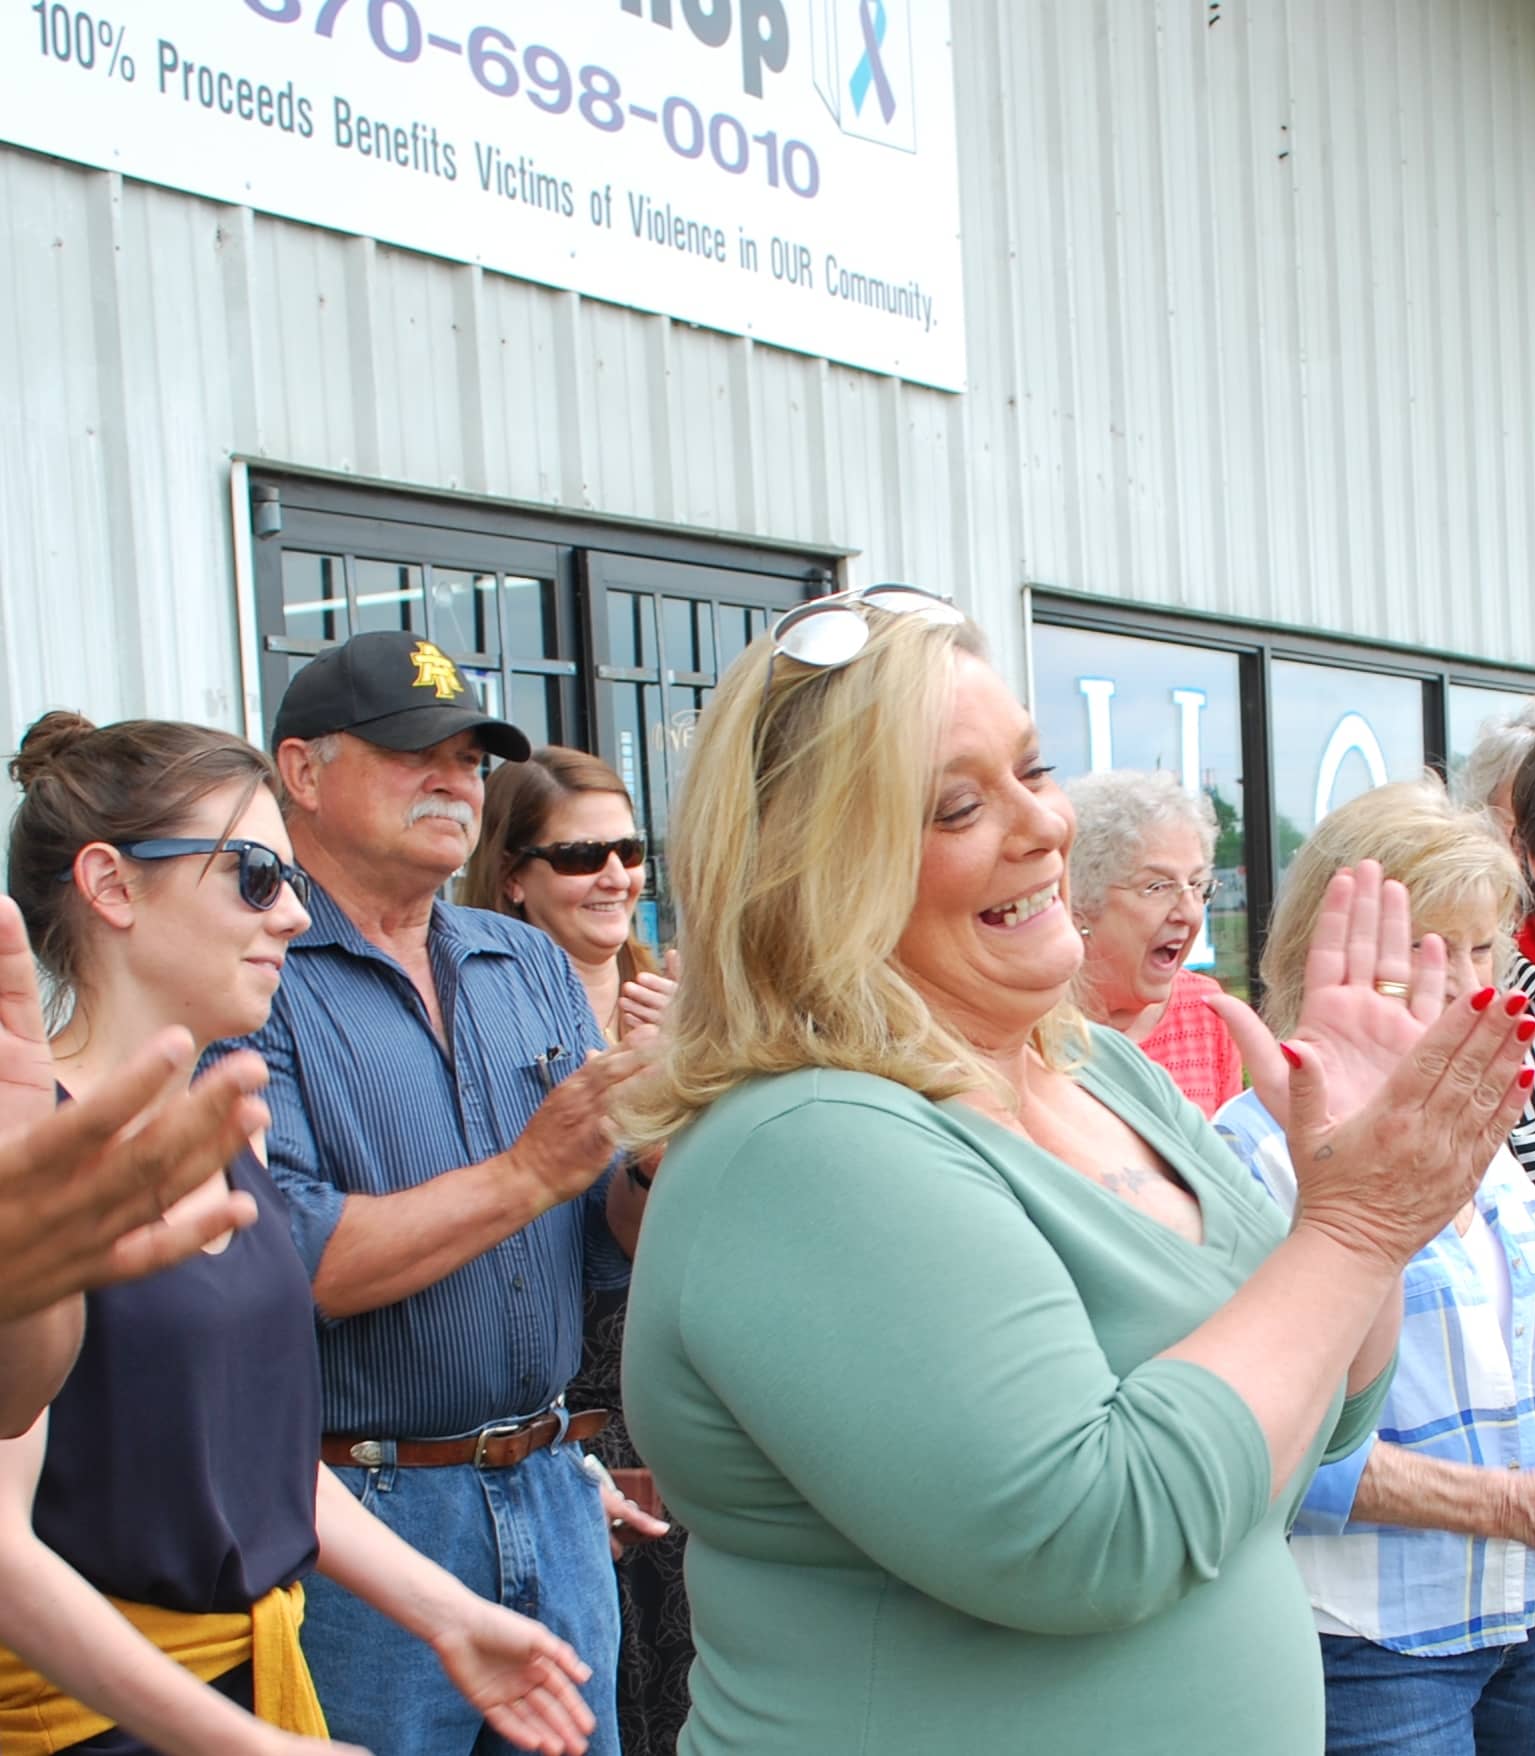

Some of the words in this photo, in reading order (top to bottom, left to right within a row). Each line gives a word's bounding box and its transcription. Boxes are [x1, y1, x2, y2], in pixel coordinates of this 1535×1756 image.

[32, 0, 135, 82] 100%
[157, 38, 313, 138] Proceeds
[333, 95, 457, 181] Benefits
[475, 141, 574, 217] Victims
[590, 184, 613, 228] of
[628, 190, 726, 263] Violence
[739, 226, 758, 272] in
[771, 236, 813, 289] OUR
[825, 254, 937, 333] Community.
